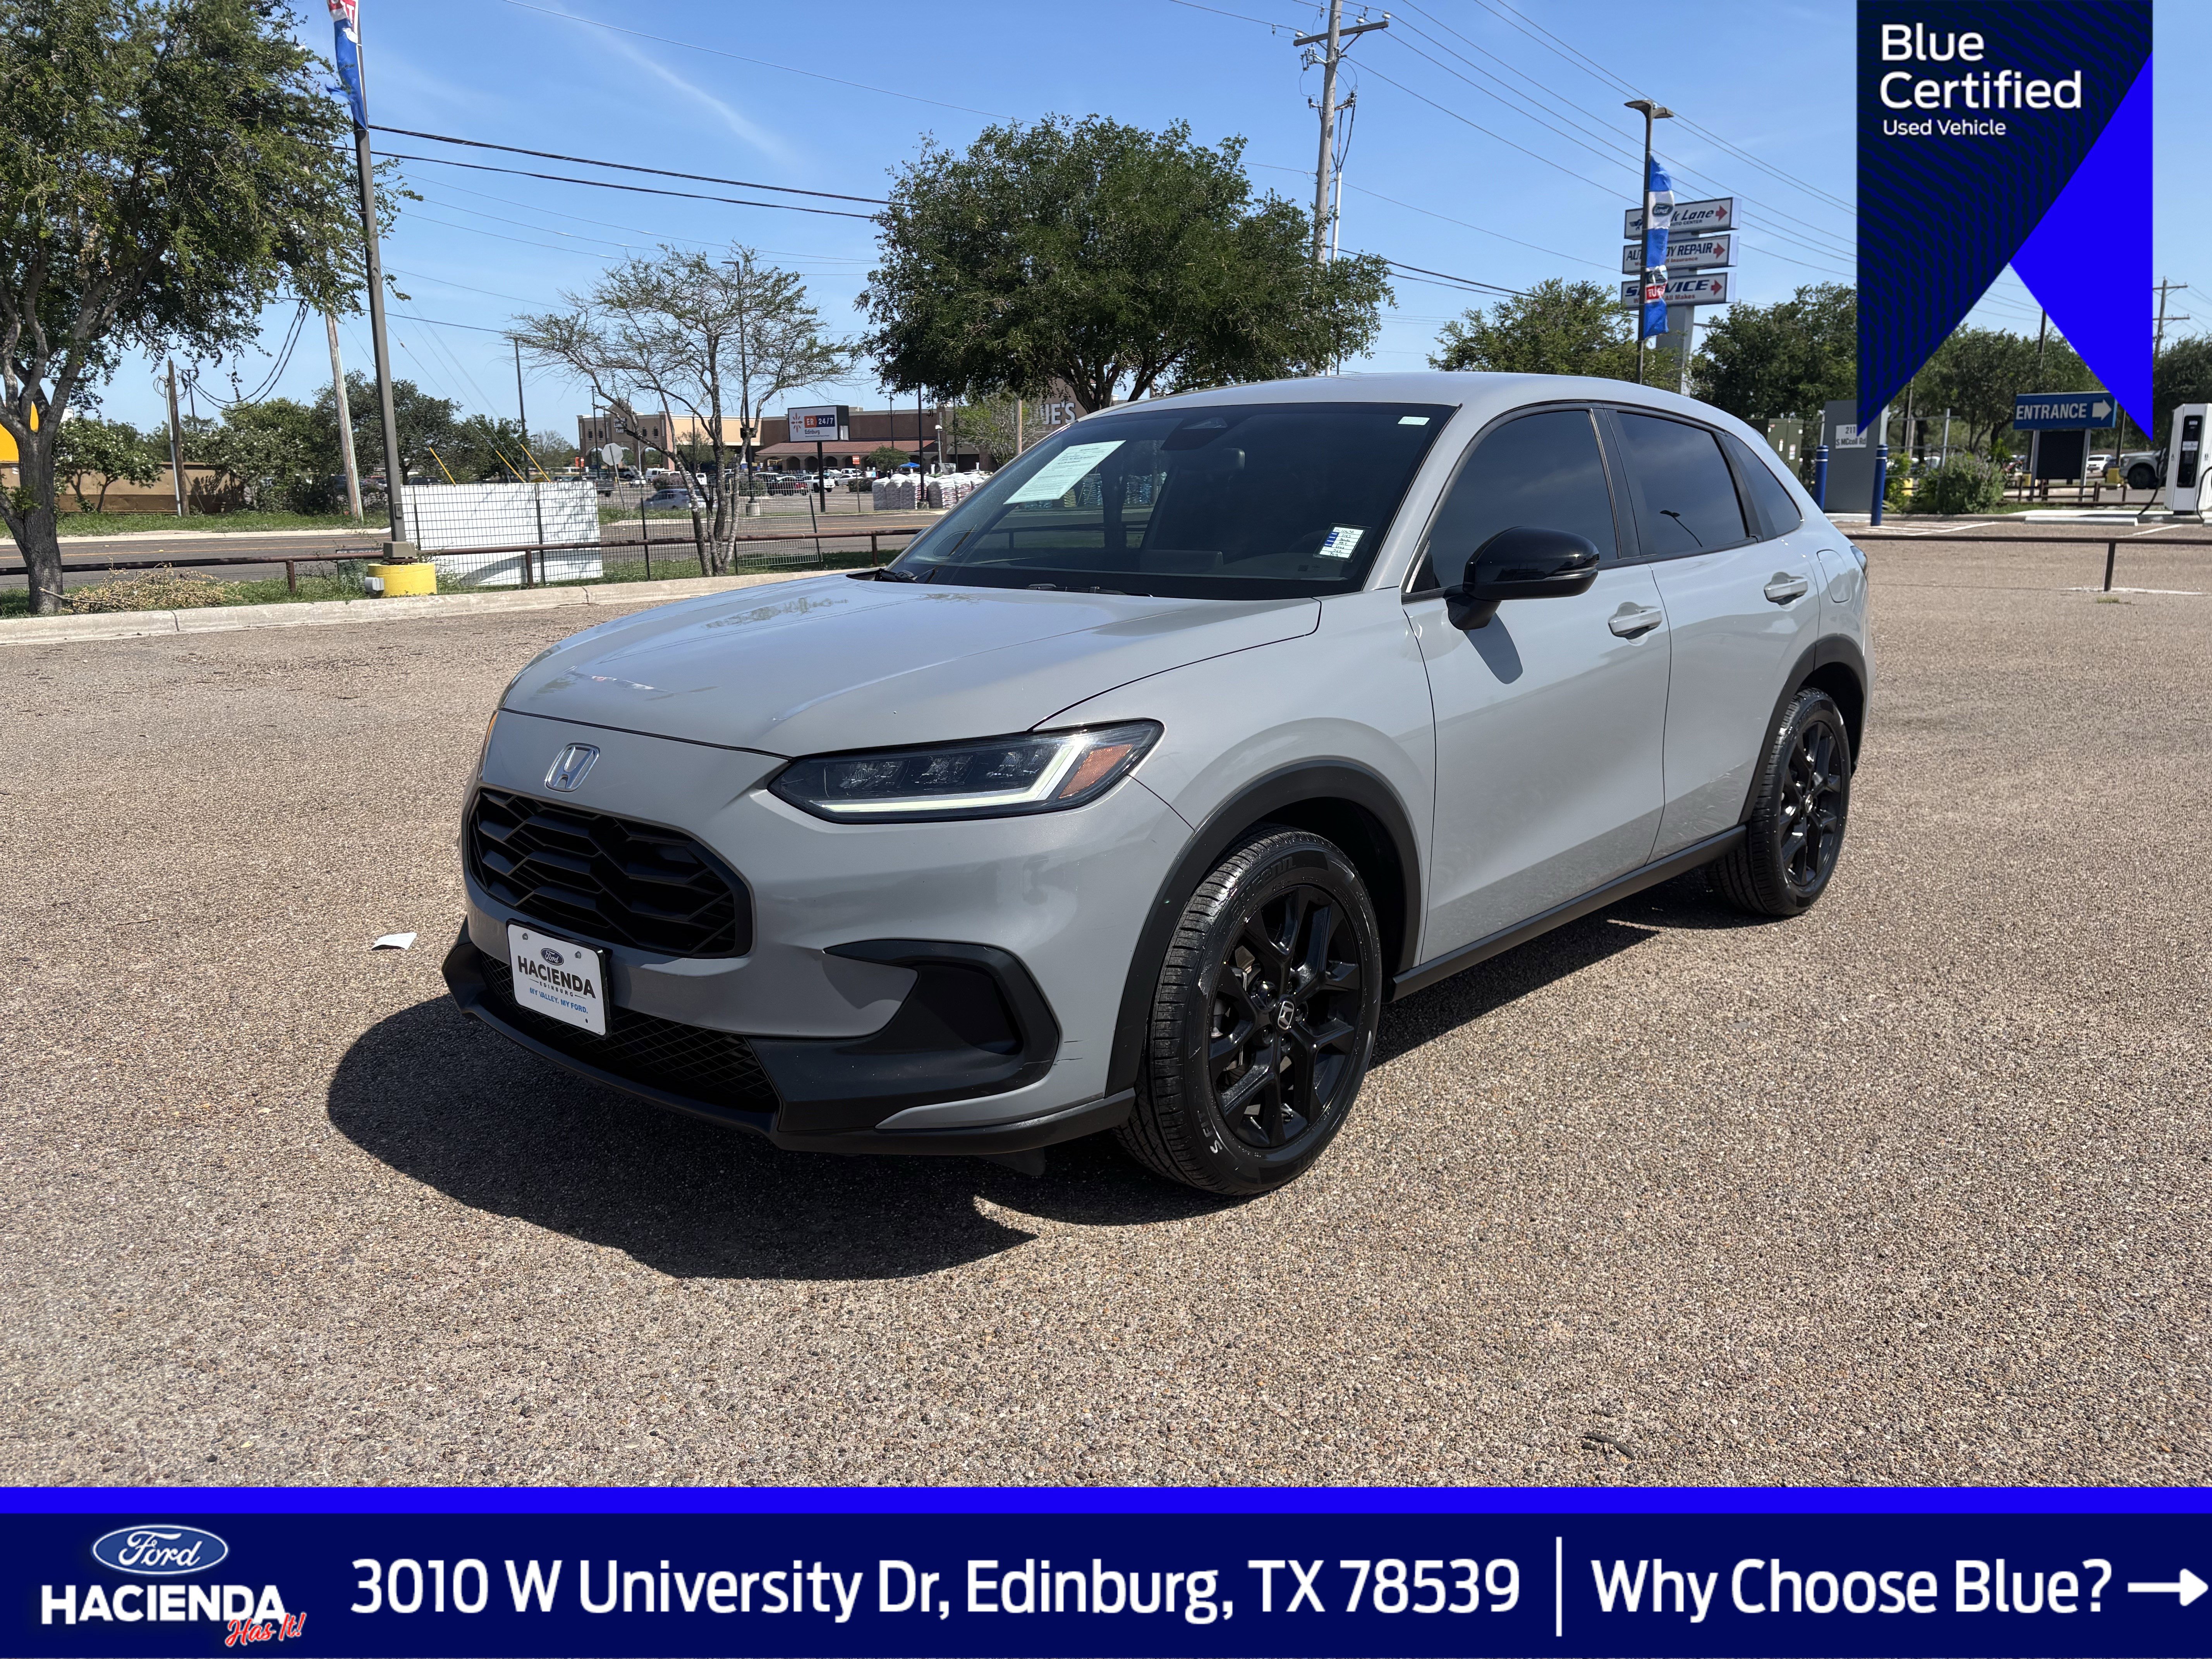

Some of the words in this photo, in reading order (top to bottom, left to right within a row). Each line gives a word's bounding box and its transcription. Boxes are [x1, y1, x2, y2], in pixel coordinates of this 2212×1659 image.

[1681, 209, 1714, 221] Lane
[1626, 249, 1642, 261] AUT
[1677, 242, 1713, 256] REPAIR
[1625, 279, 1710, 297] SVICE
[2015, 403, 2087, 420] ENTRANCE
[545, 950, 559, 963] Ford
[517, 955, 596, 999] HACIENDA
[539, 981, 574, 997] EDINBURG
[530, 987, 538, 995] MY
[539, 991, 559, 1004] VALLEY.
[560, 999, 570, 1008] MY
[570, 1002, 588, 1014] FORD.
